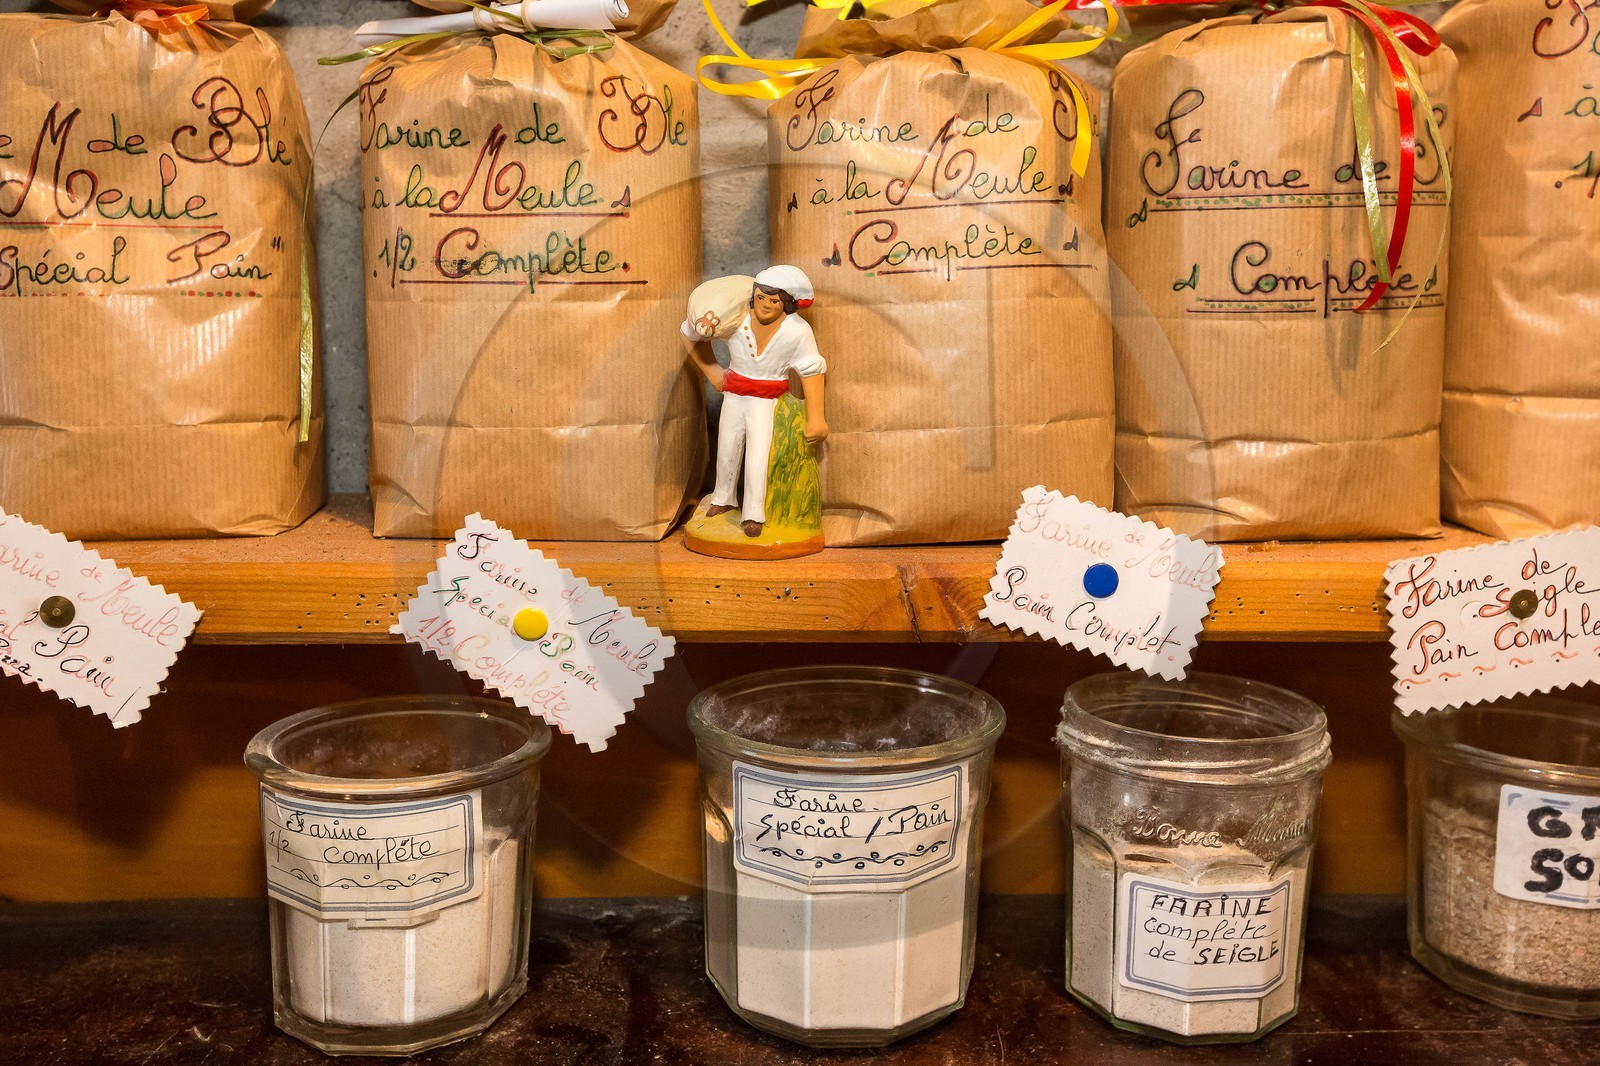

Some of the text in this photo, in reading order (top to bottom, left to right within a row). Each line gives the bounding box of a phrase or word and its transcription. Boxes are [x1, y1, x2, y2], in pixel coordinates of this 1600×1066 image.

[87, 113, 148, 155] de
[359, 66, 688, 156] Farine de Blé
[786, 69, 919, 152] Farine
[963, 93, 1019, 138] de
[0, 100, 218, 220] Meule
[372, 123, 603, 212] à la Meule
[810, 113, 1052, 206] à la Meule
[1141, 88, 1309, 197] Farine
[1335, 135, 1390, 184] de
[0, 236, 130, 297] Spécial
[849, 219, 1042, 282] Complète
[80, 565, 103, 584] de
[1019, 495, 1218, 593] Farine de Meule
[77, 578, 180, 647] Meule
[432, 575, 520, 634] Spécia
[457, 532, 538, 602] Farine
[567, 609, 649, 677] Meule
[992, 566, 1055, 623] Pain
[1394, 547, 1568, 619] Farine de
[1478, 565, 1600, 618] Sigle
[32, 624, 115, 698] Pain
[417, 614, 457, 647] 1/2
[1407, 620, 1479, 676] Pain
[269, 830, 290, 863] 1/2
[286, 811, 374, 842] Farine
[756, 813, 853, 842] Spécial
[886, 804, 952, 836] Pain
[1148, 940, 1177, 962] de
